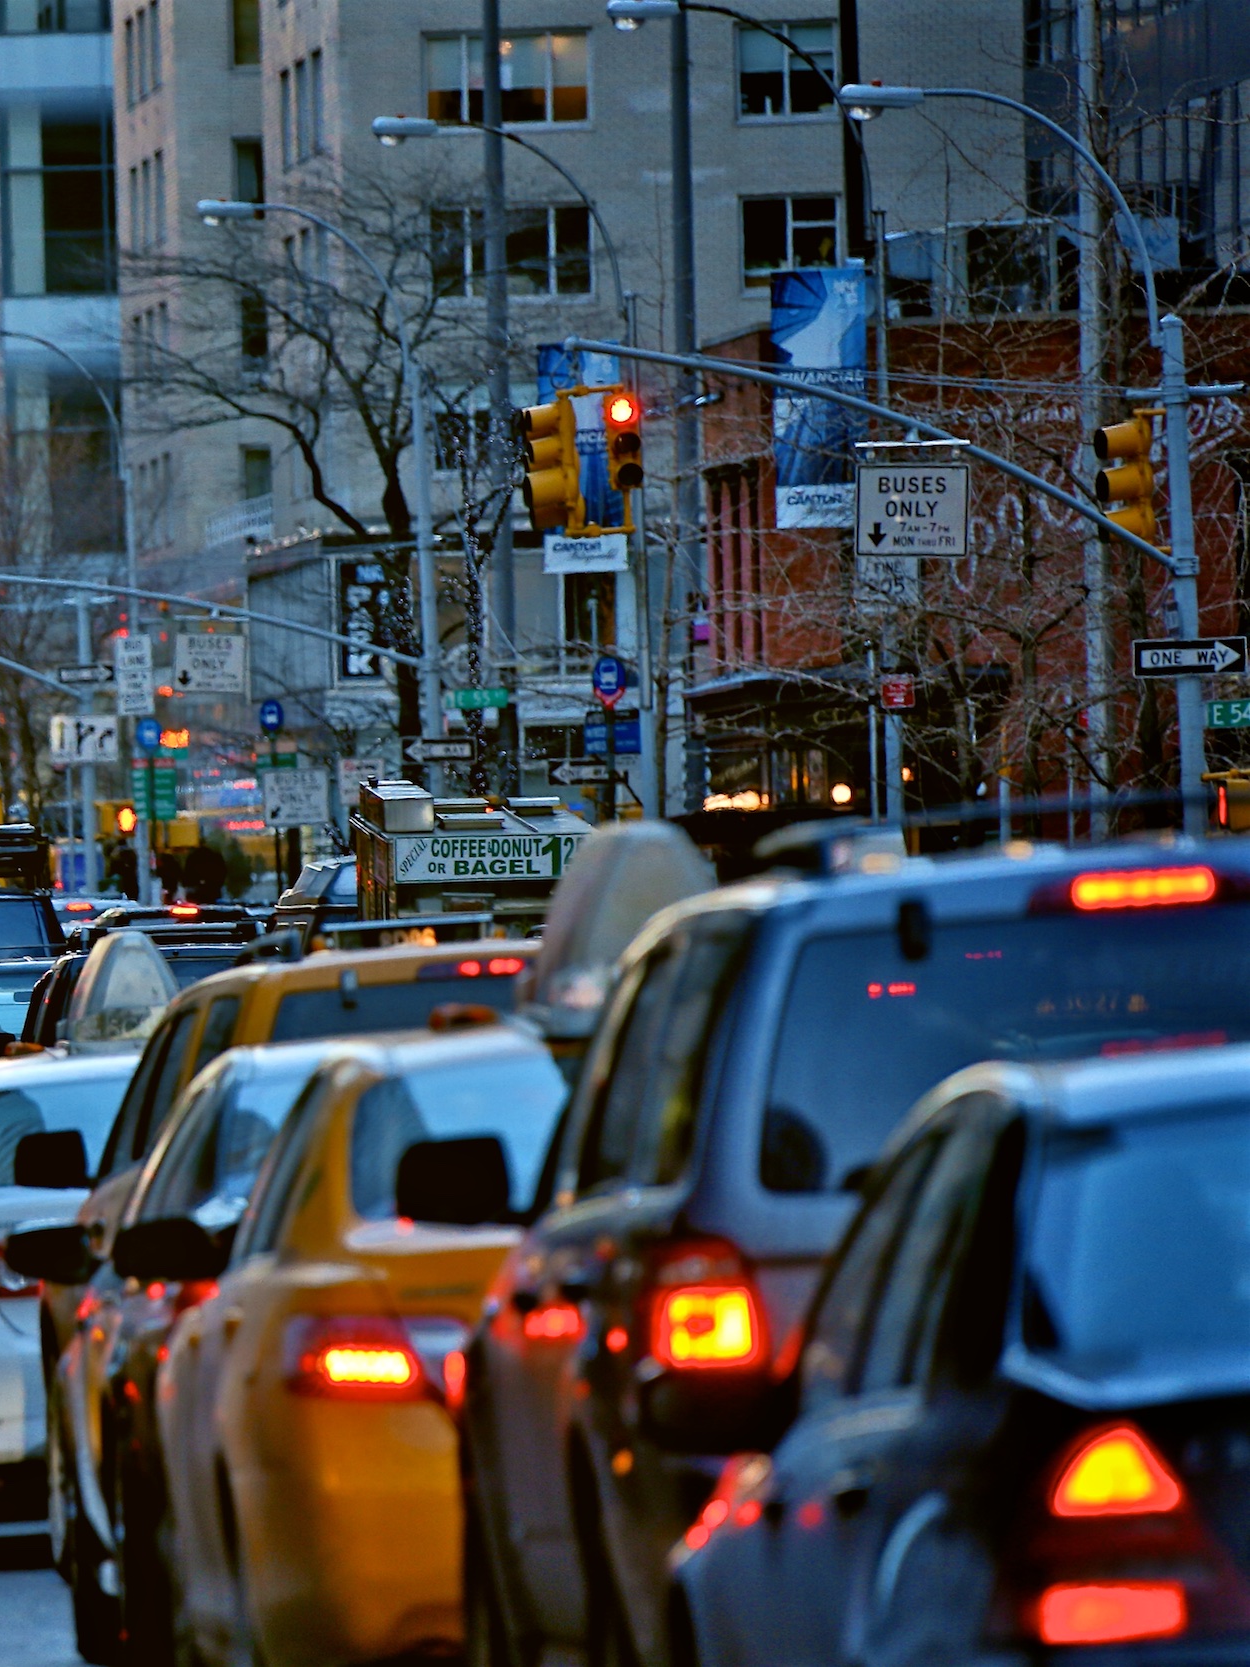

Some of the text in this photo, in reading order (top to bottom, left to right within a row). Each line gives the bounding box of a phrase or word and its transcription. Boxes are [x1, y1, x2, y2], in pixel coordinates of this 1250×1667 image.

[878, 476, 947, 494] BUSES
[885, 501, 938, 518] ONLY
[892, 536, 915, 547] MON
[938, 536, 956, 547] FRI
[1151, 648, 1229, 666] ONE WAY
[1212, 703, 1225, 726] E
[431, 838, 489, 859] COFFEE
[490, 837, 543, 858] DONUT
[399, 838, 428, 877] SPECIAL
[428, 858, 541, 876] OR BAGEL
